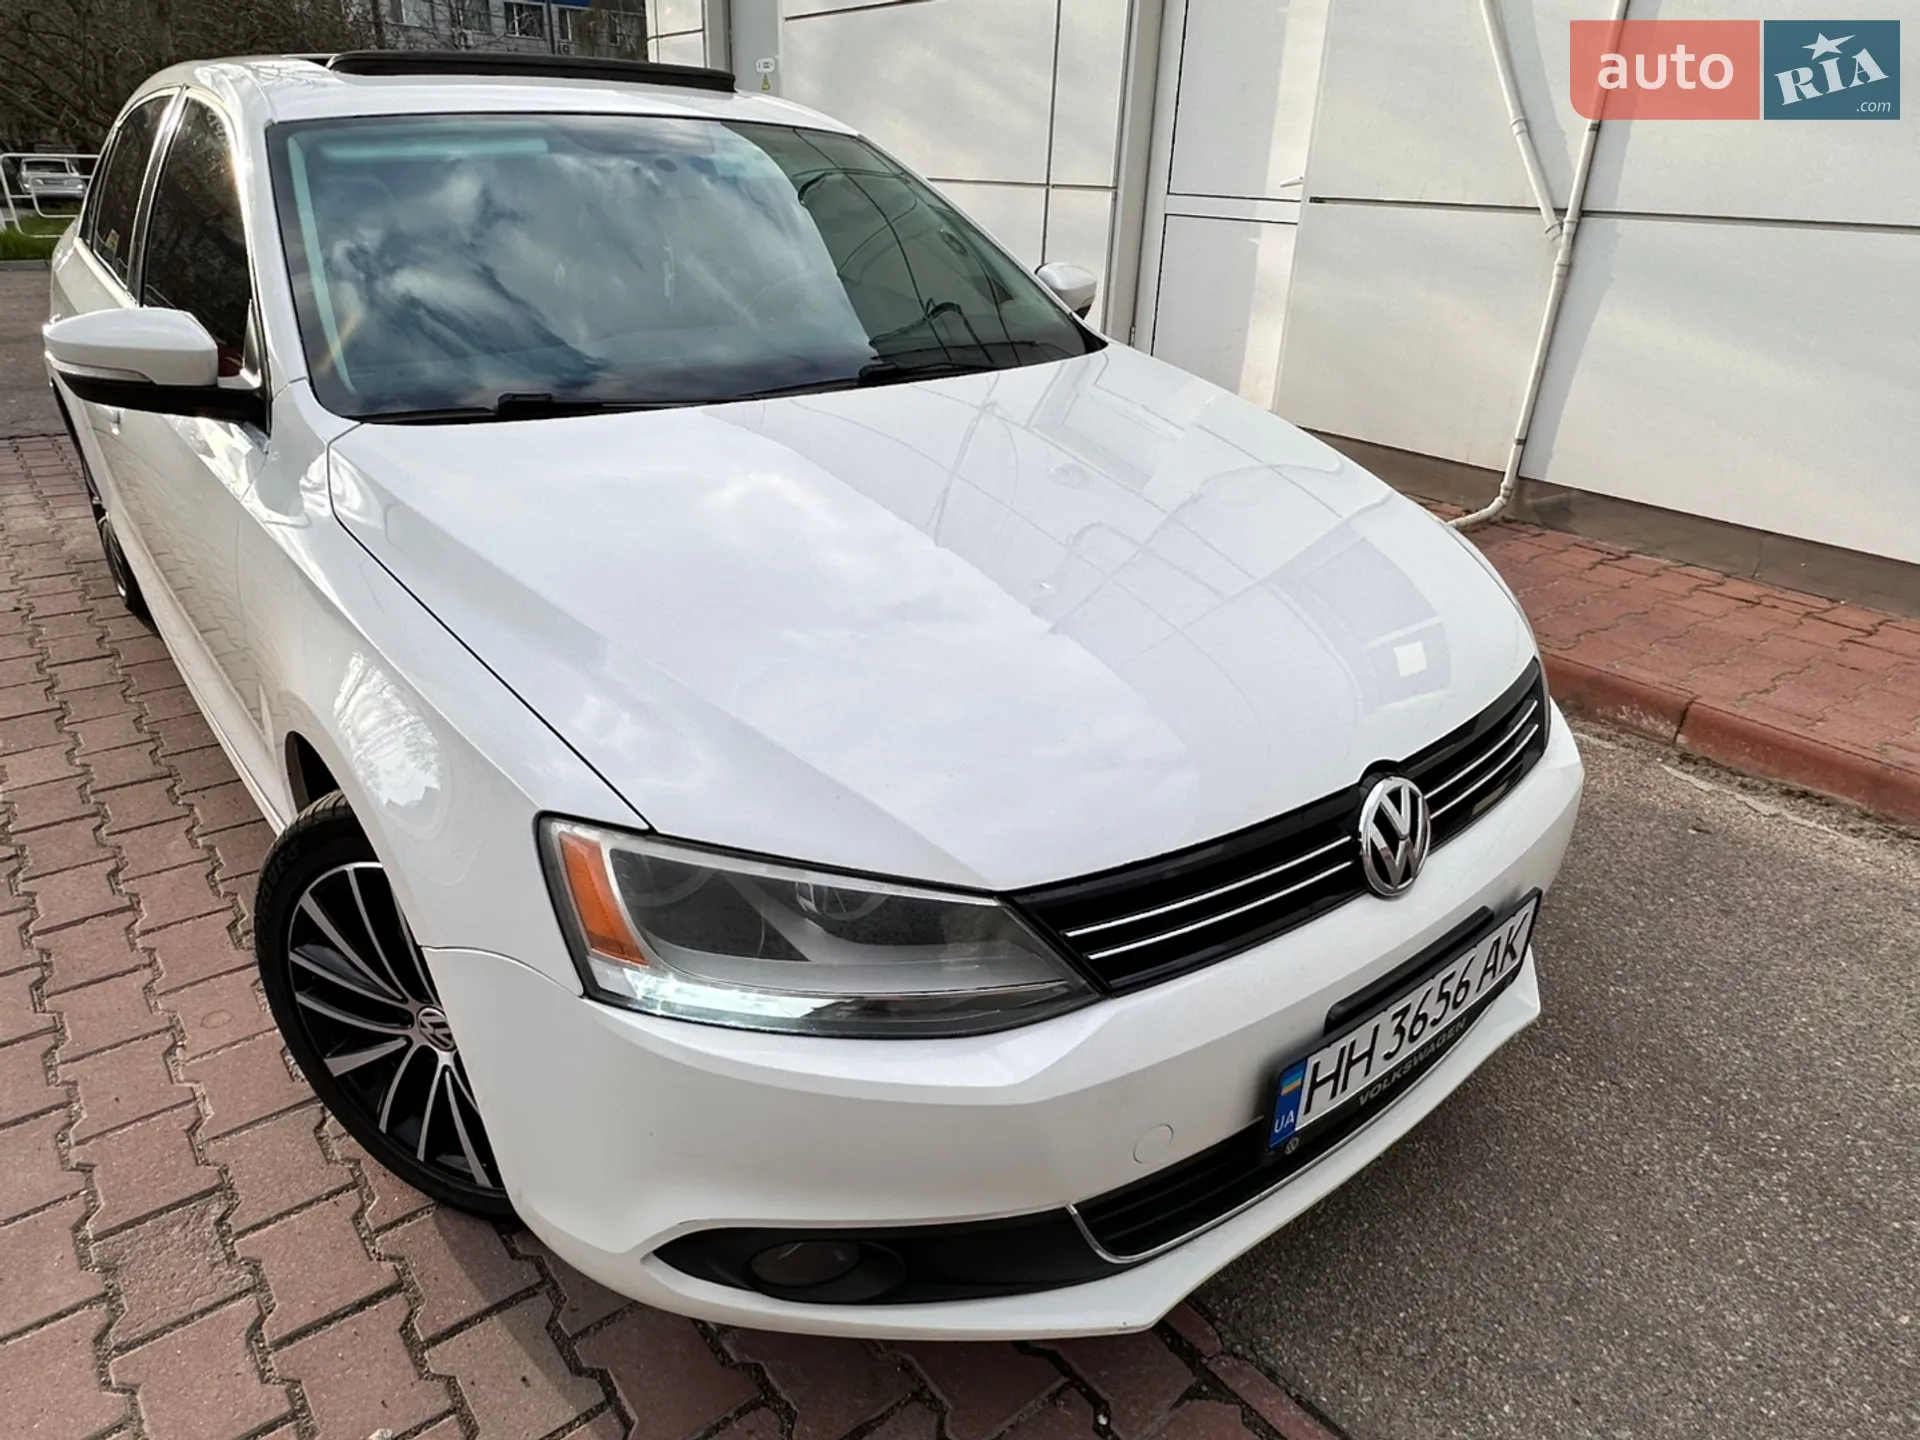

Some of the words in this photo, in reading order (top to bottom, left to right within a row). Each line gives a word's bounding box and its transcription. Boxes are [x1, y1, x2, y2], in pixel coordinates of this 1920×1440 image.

[1303, 1023, 1380, 1116] HH
[1383, 954, 1476, 1061] 3656
[1475, 911, 1530, 994] AK
[1359, 1016, 1467, 1106] VOLKSWAGEN
[1274, 1110, 1295, 1133] UA
